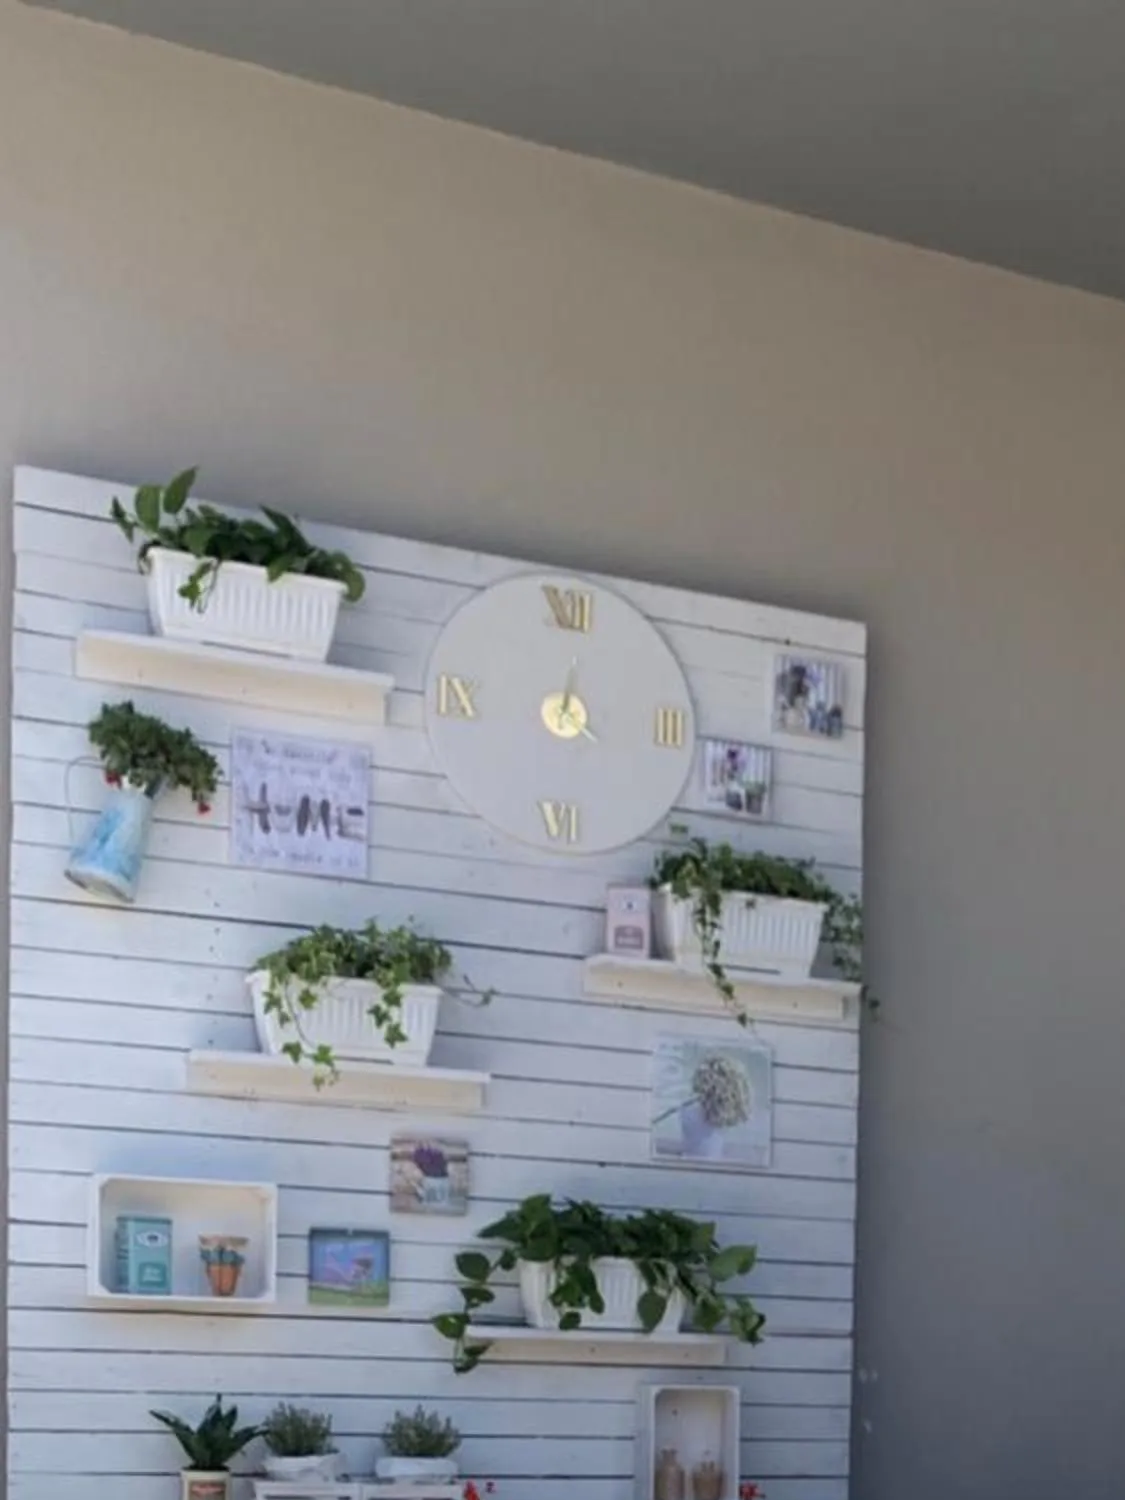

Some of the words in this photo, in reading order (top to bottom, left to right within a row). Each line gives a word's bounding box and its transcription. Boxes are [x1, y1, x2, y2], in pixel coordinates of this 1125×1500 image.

[437, 673, 482, 717] IX
[654, 707, 684, 747] III
[240, 781, 365, 842] HOME
[537, 800, 579, 844] VI
